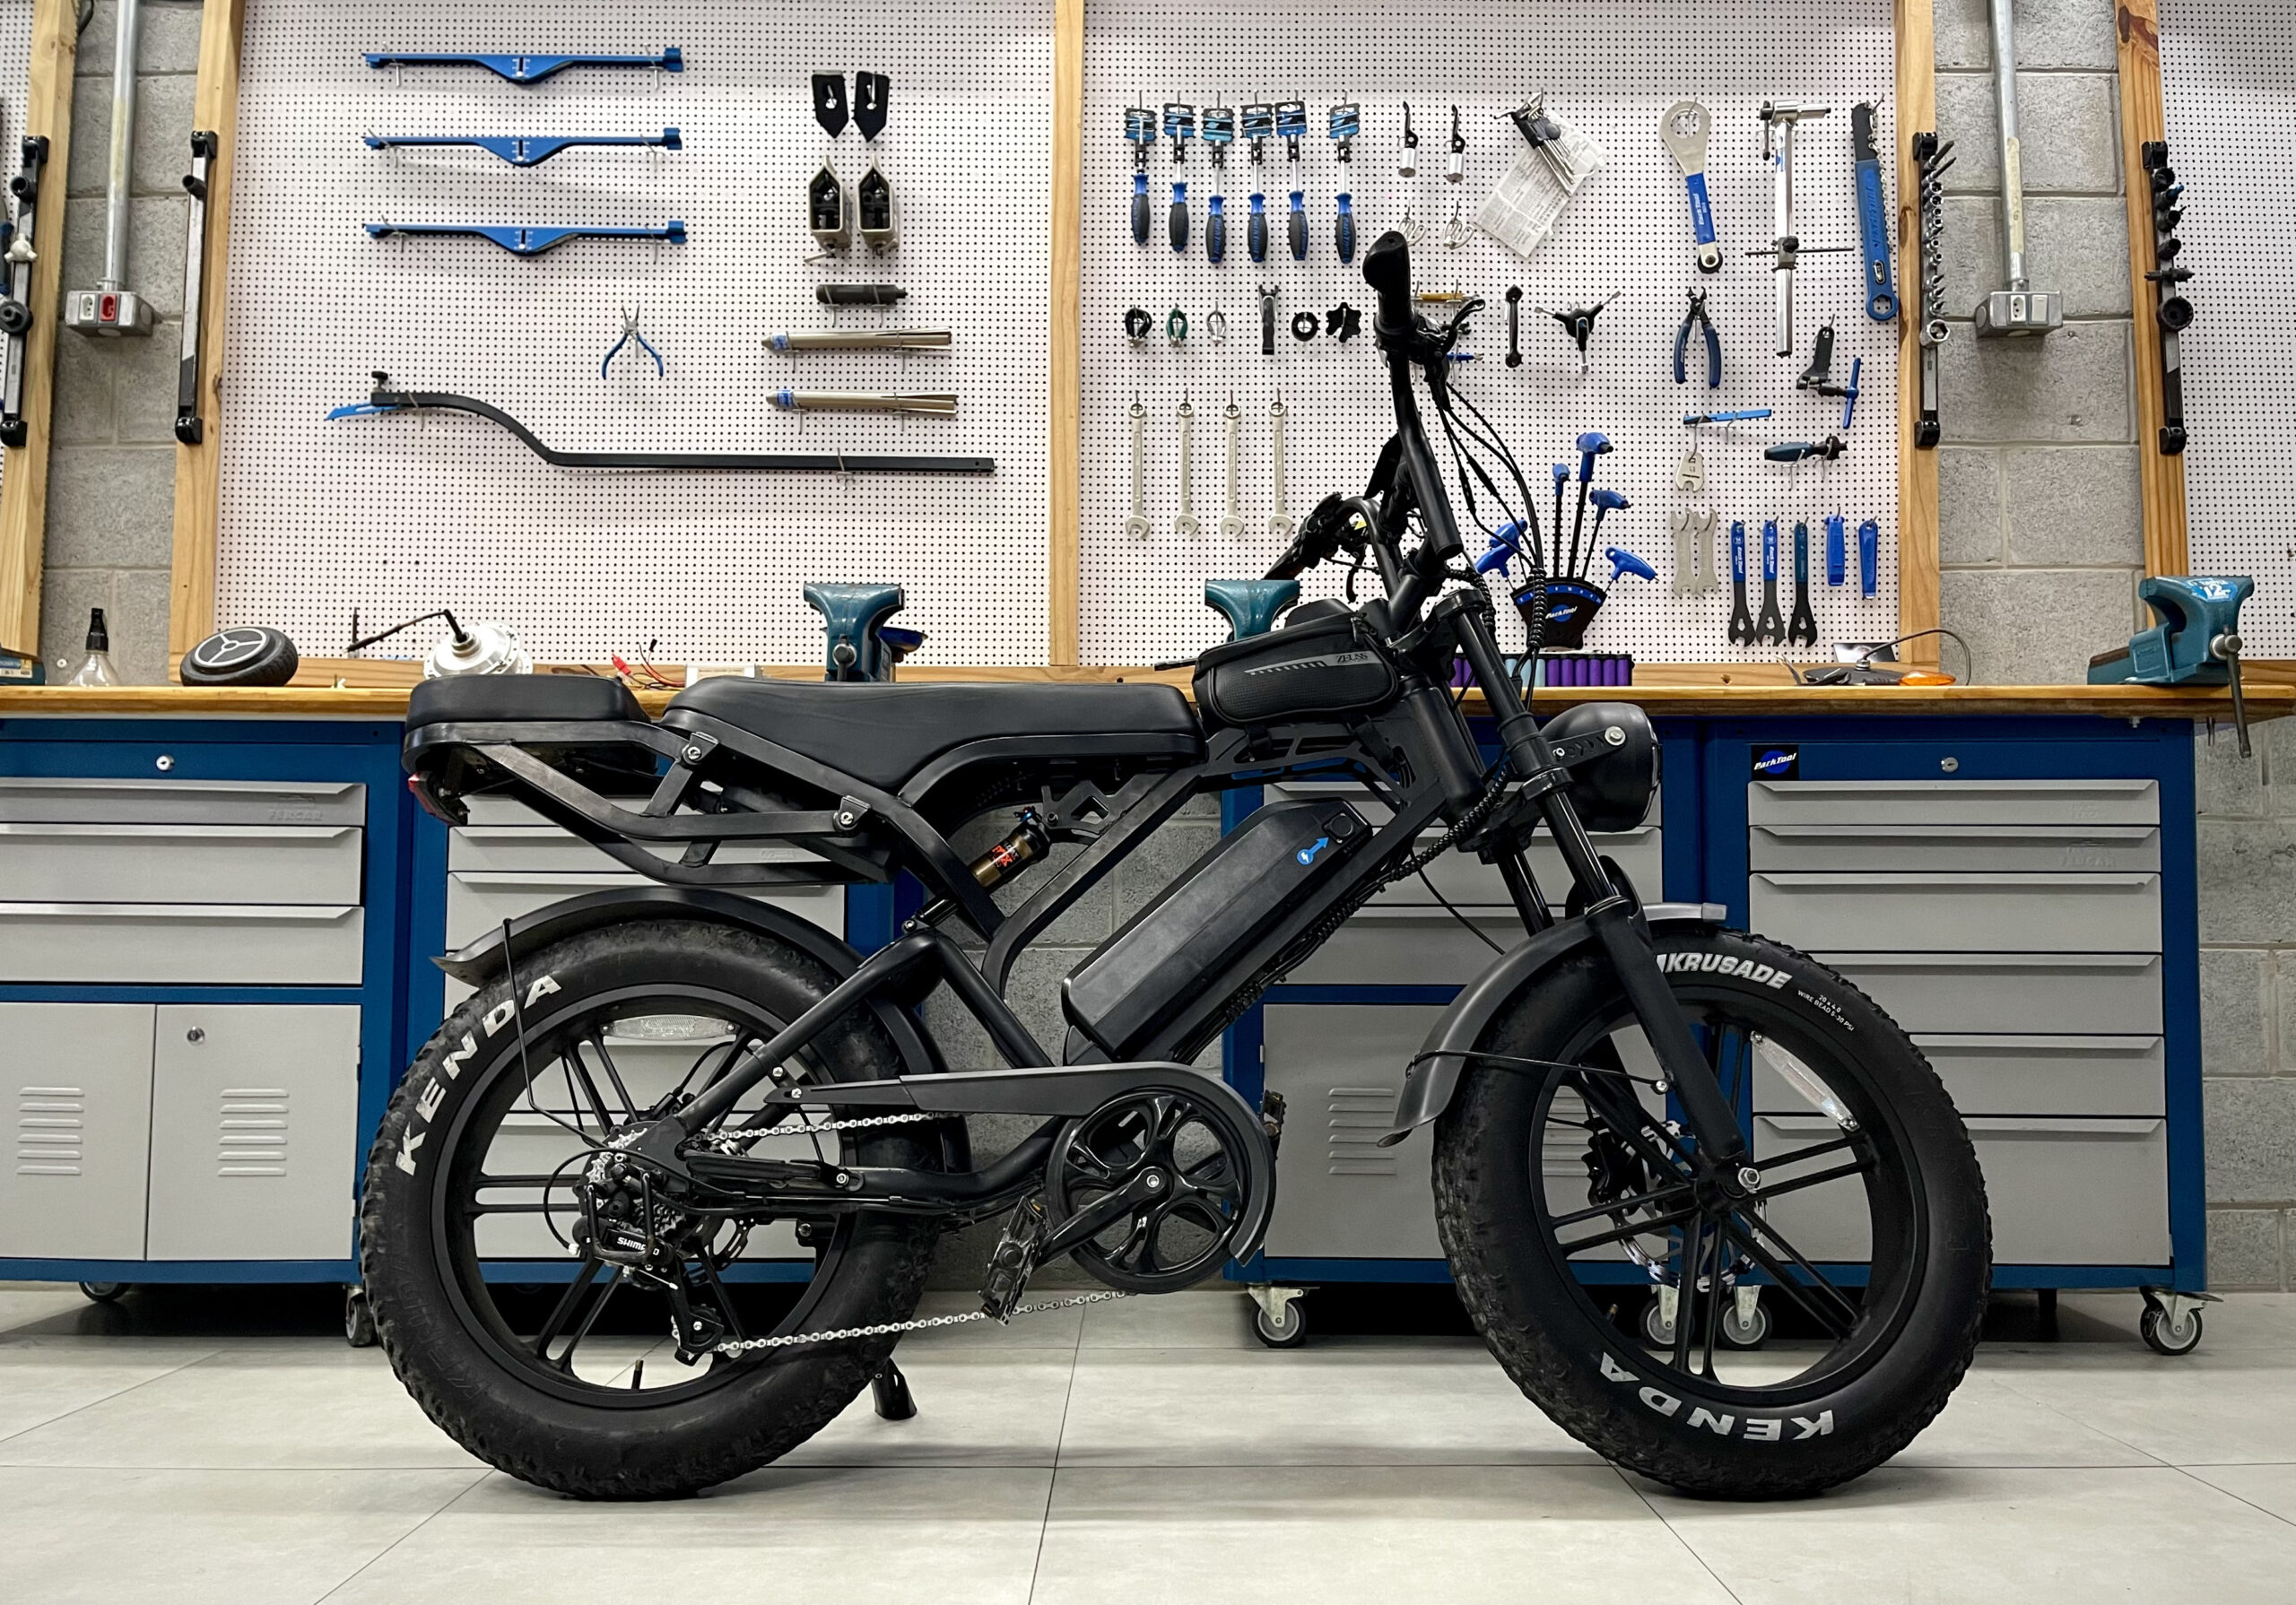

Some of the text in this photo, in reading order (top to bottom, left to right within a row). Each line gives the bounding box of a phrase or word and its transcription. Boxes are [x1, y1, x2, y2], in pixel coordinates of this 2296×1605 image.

[1797, 990, 1855, 1031] WIRE BEAD 5-30 PSI
[1818, 994, 1827, 1002] 20
[396, 975, 561, 1176] KENDA
[1599, 1351, 1834, 1442] KENDA
